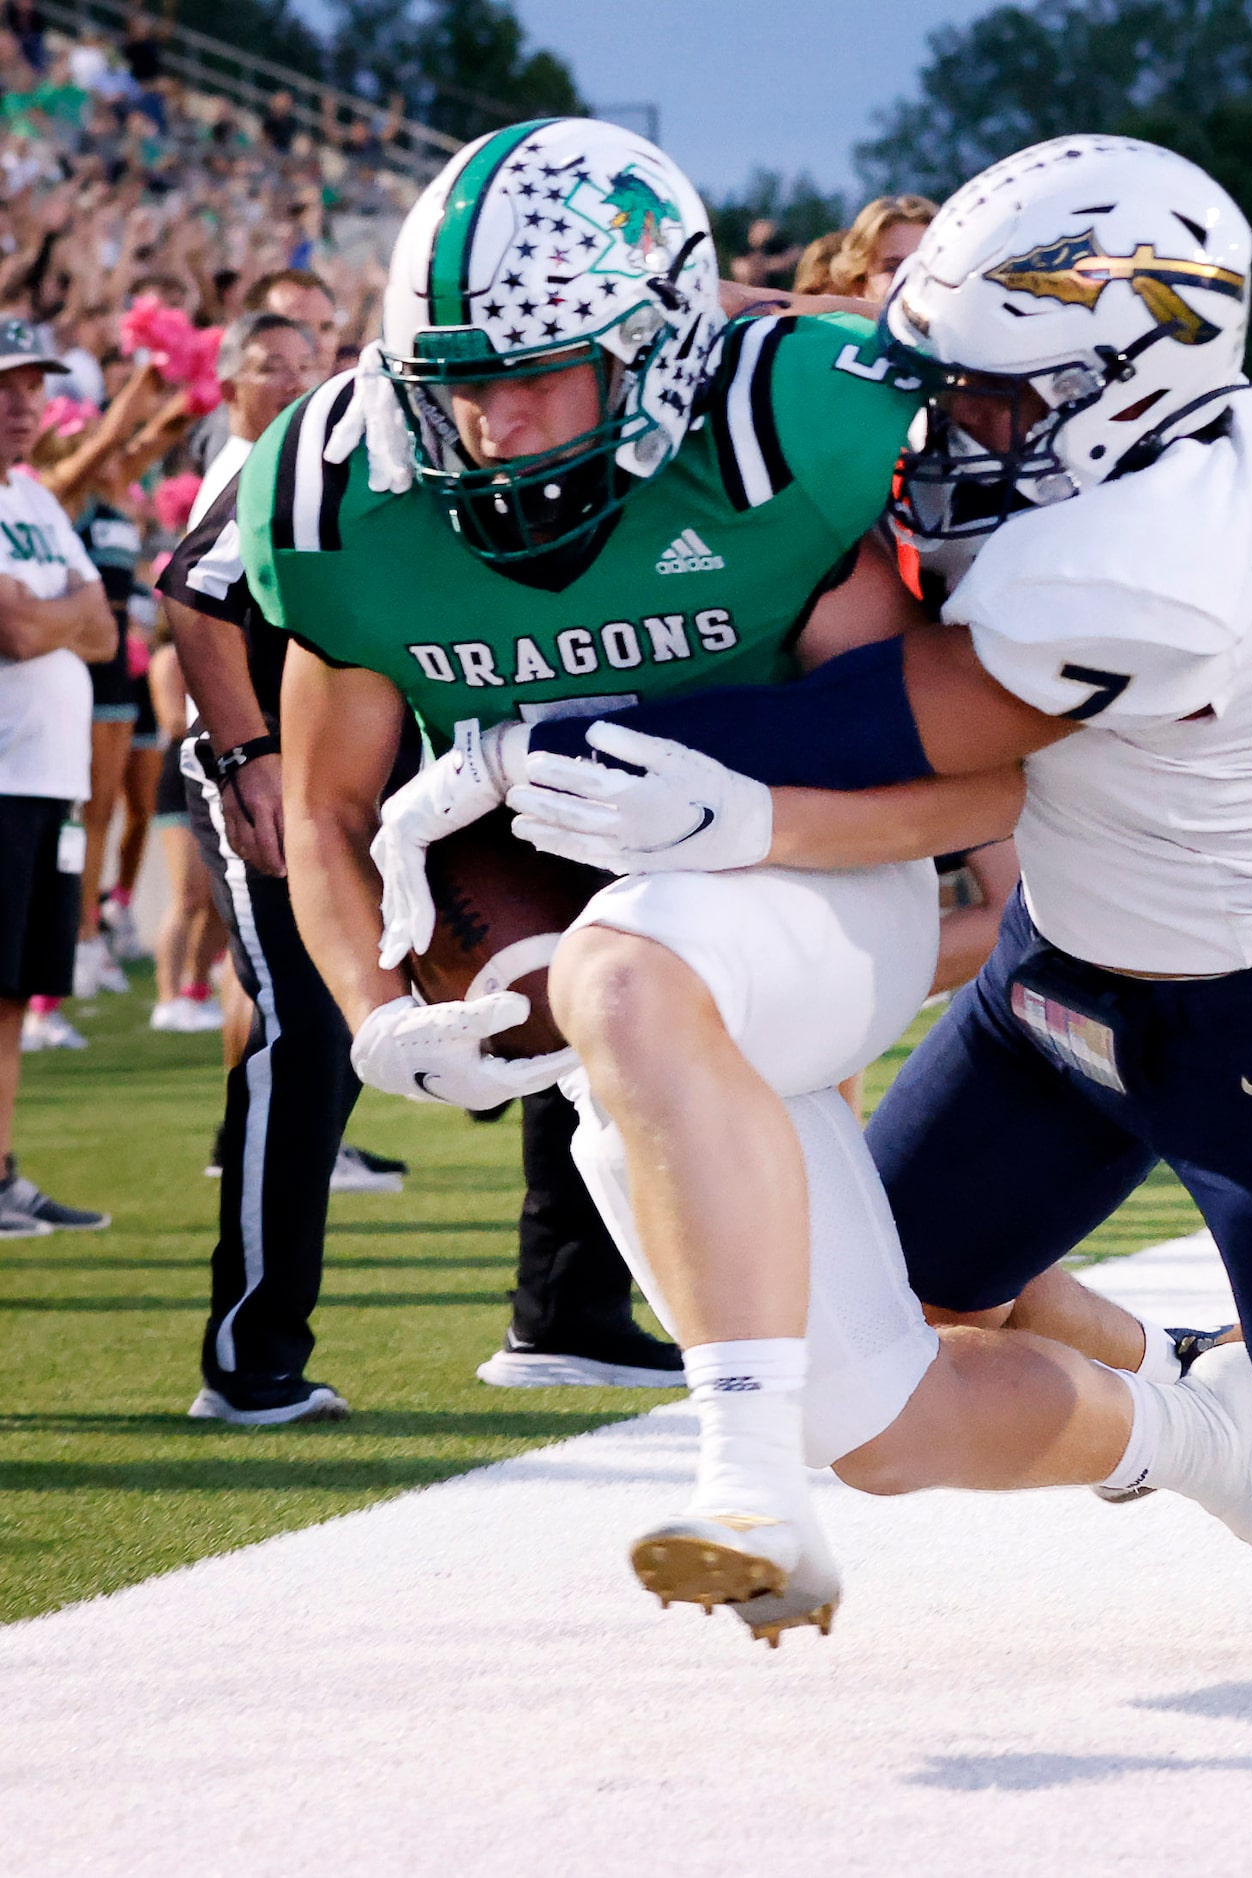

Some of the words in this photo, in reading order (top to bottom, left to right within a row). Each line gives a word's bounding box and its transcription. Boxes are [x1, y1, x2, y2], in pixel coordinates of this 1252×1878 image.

[655, 555, 725, 575] adidas
[408, 607, 739, 688] DRAGONS
[1058, 661, 1134, 722] 7
